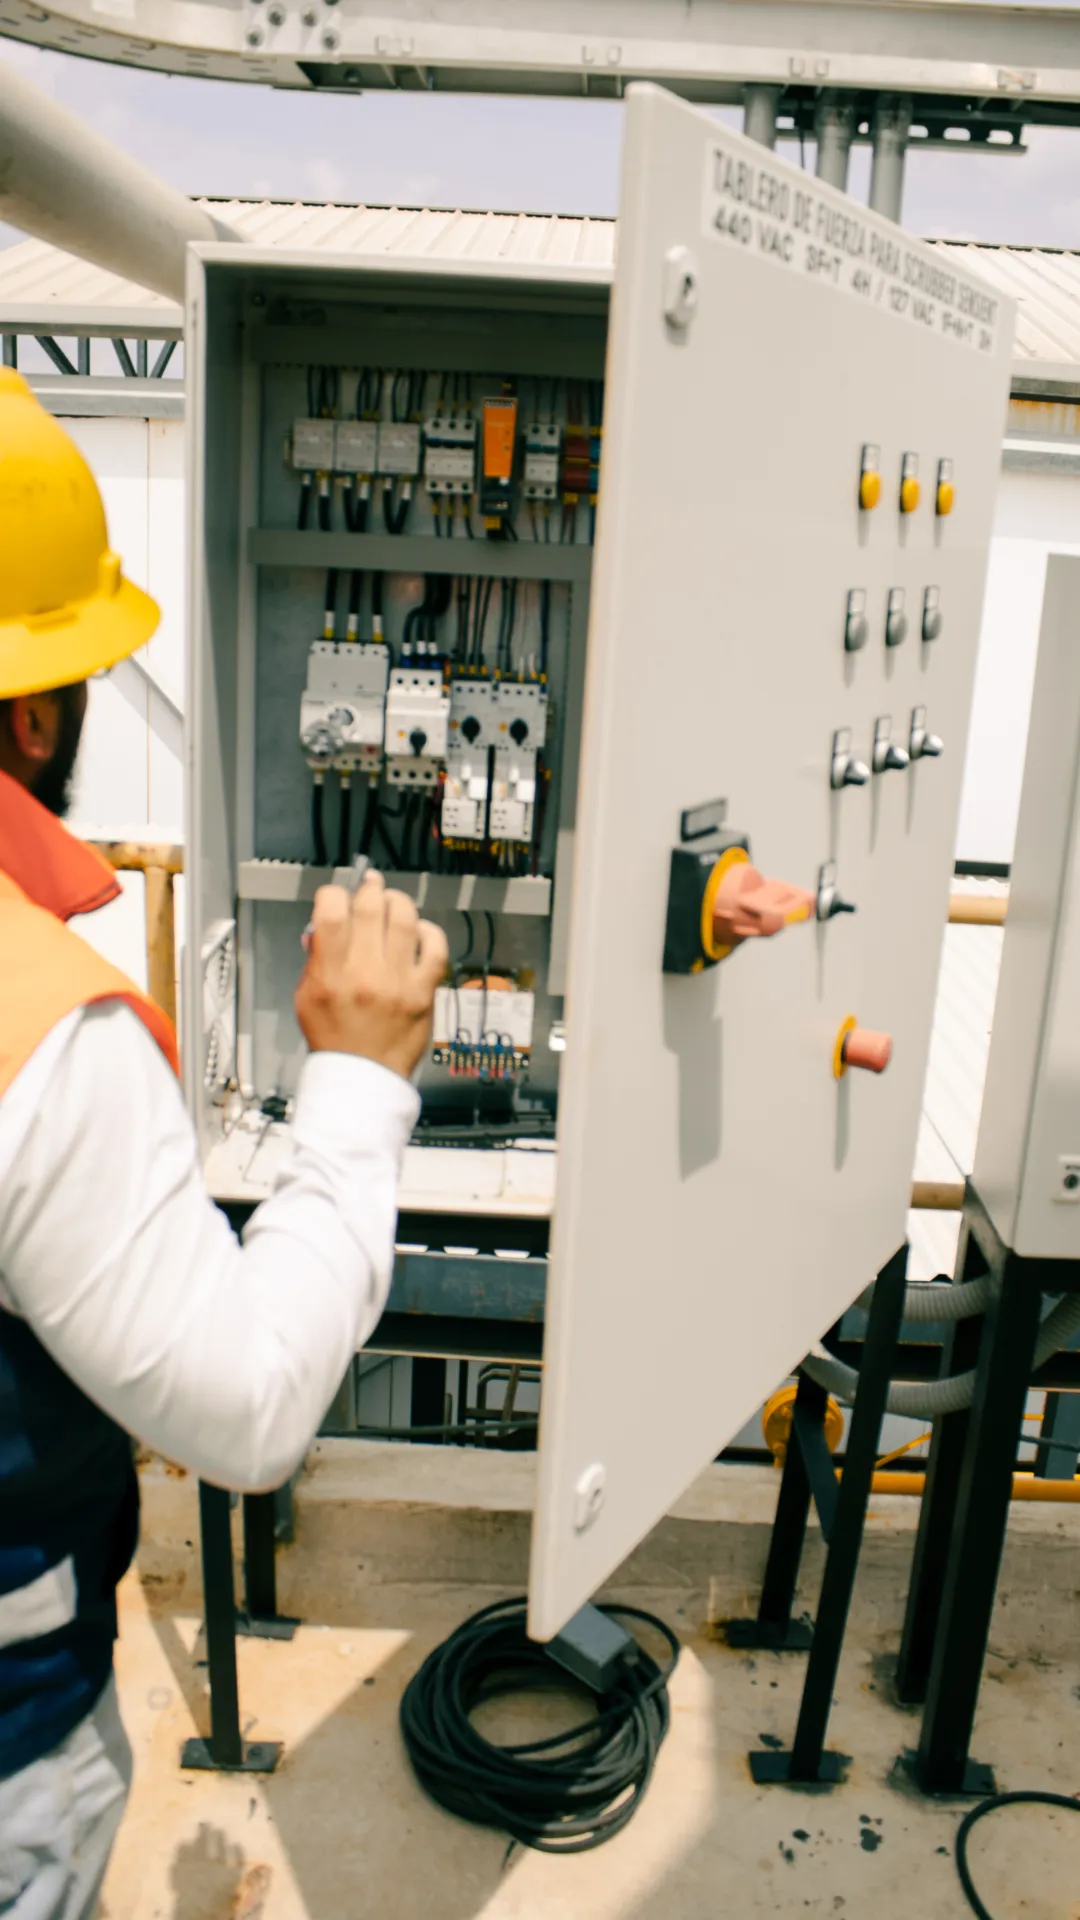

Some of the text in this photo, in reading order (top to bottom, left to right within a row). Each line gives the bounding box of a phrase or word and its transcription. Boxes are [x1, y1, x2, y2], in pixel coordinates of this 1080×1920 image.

[713, 148, 790, 222] TABLERO
[793, 189, 813, 234] DE
[815, 202, 866, 261] FUERZA
[713, 204, 752, 244] 440
[757, 219, 795, 263] VAC
